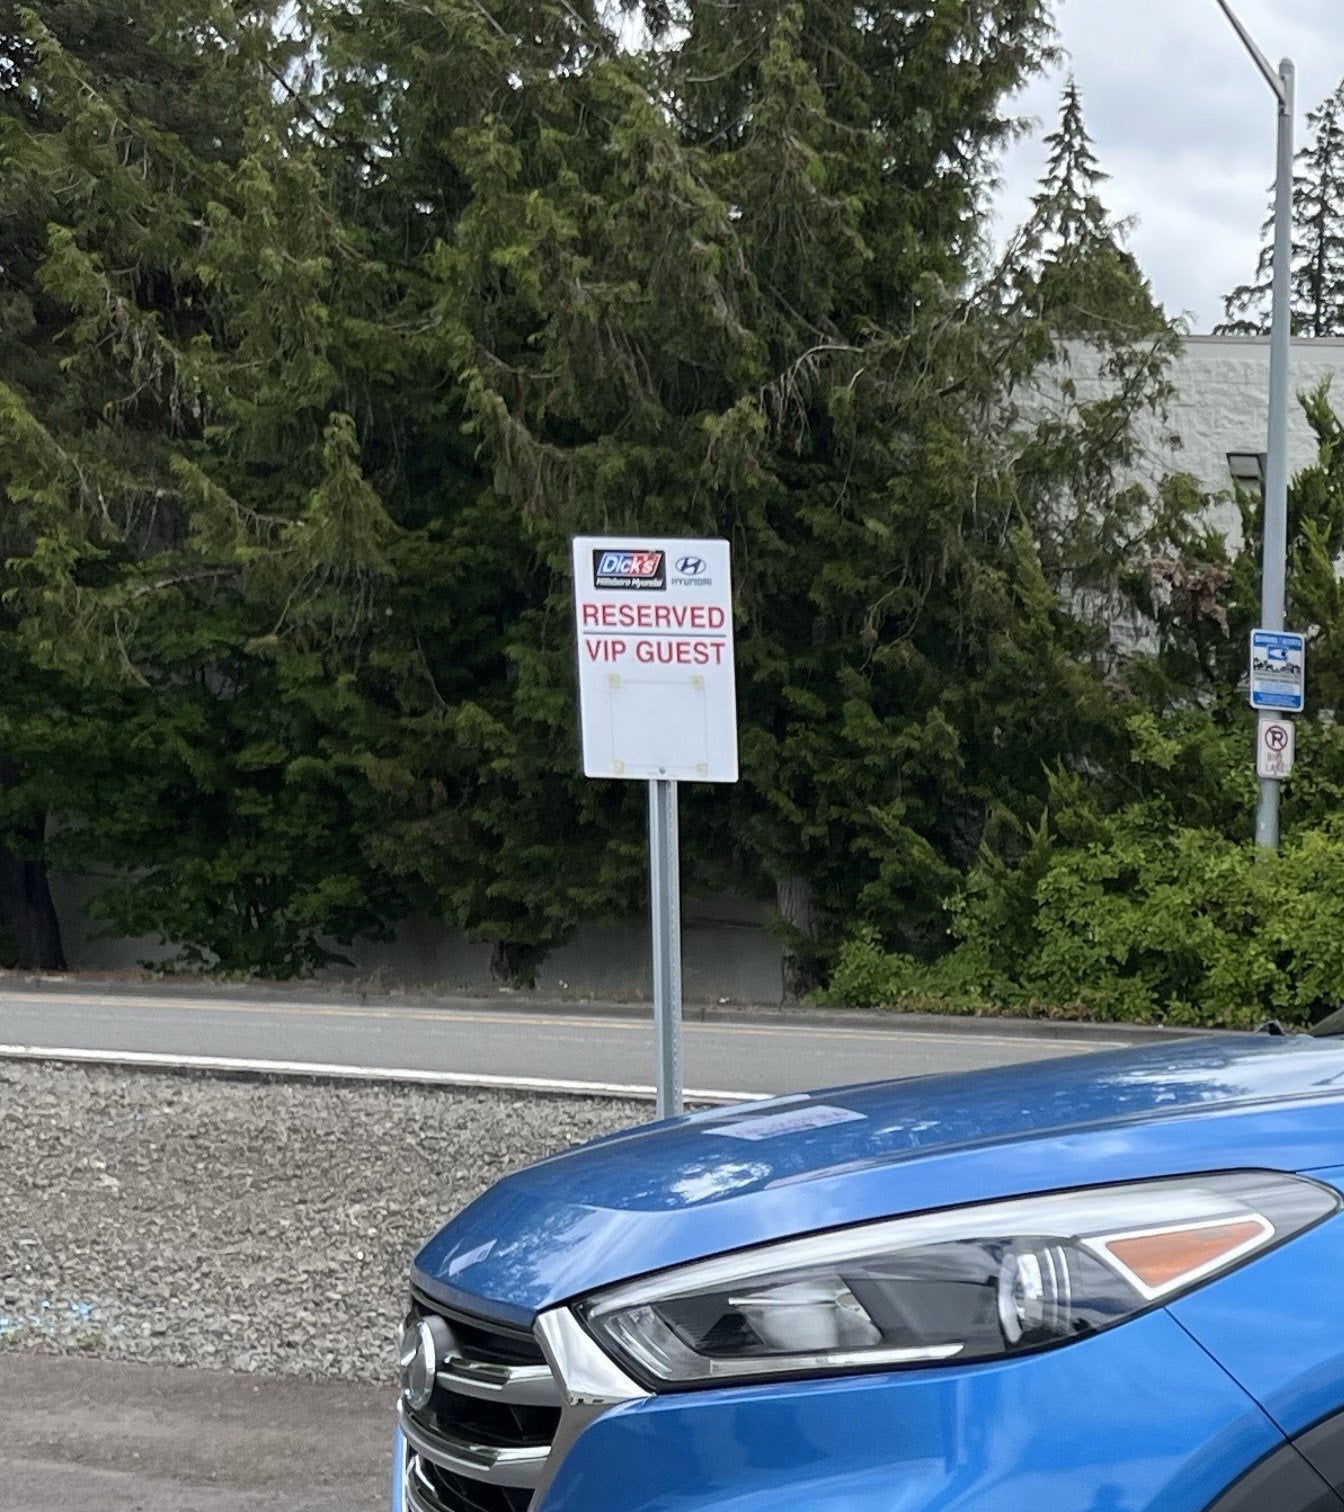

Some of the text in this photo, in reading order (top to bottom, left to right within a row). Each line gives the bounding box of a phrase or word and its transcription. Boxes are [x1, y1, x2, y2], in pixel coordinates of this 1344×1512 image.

[583, 604, 725, 629] RESERVED
[585, 639, 726, 665] VIP GUEST
